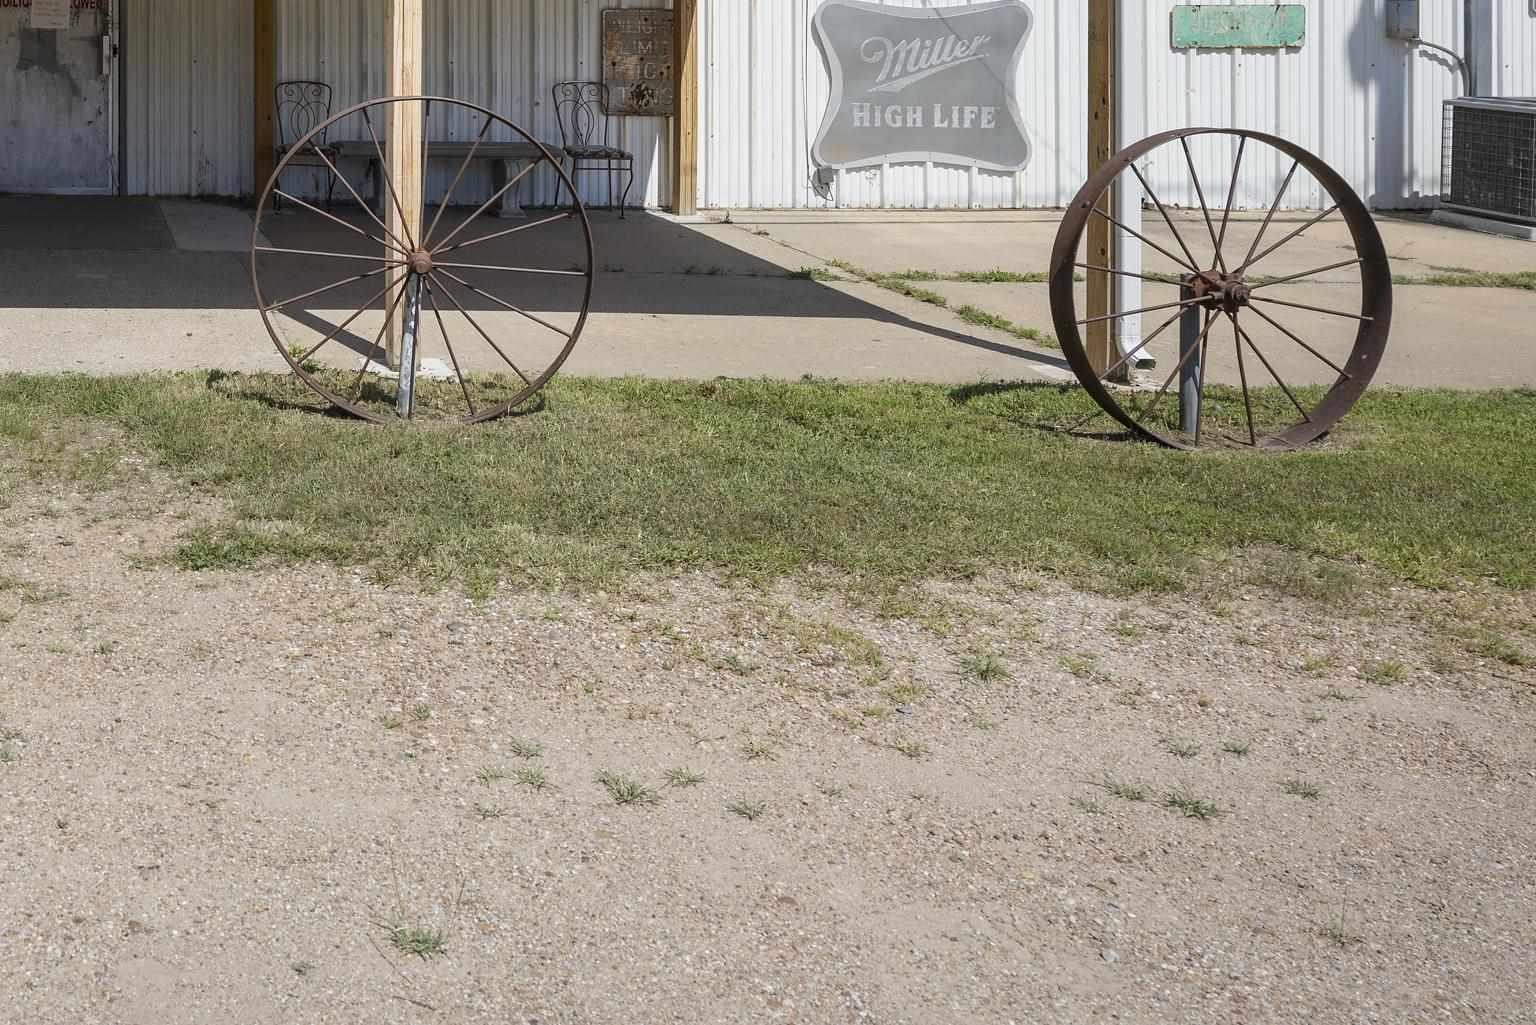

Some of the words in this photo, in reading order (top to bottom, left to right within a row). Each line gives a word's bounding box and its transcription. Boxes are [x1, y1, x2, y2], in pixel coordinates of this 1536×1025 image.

[860, 34, 992, 83] Miller
[852, 102, 923, 128] HIGH
[933, 103, 998, 129] LIFE
